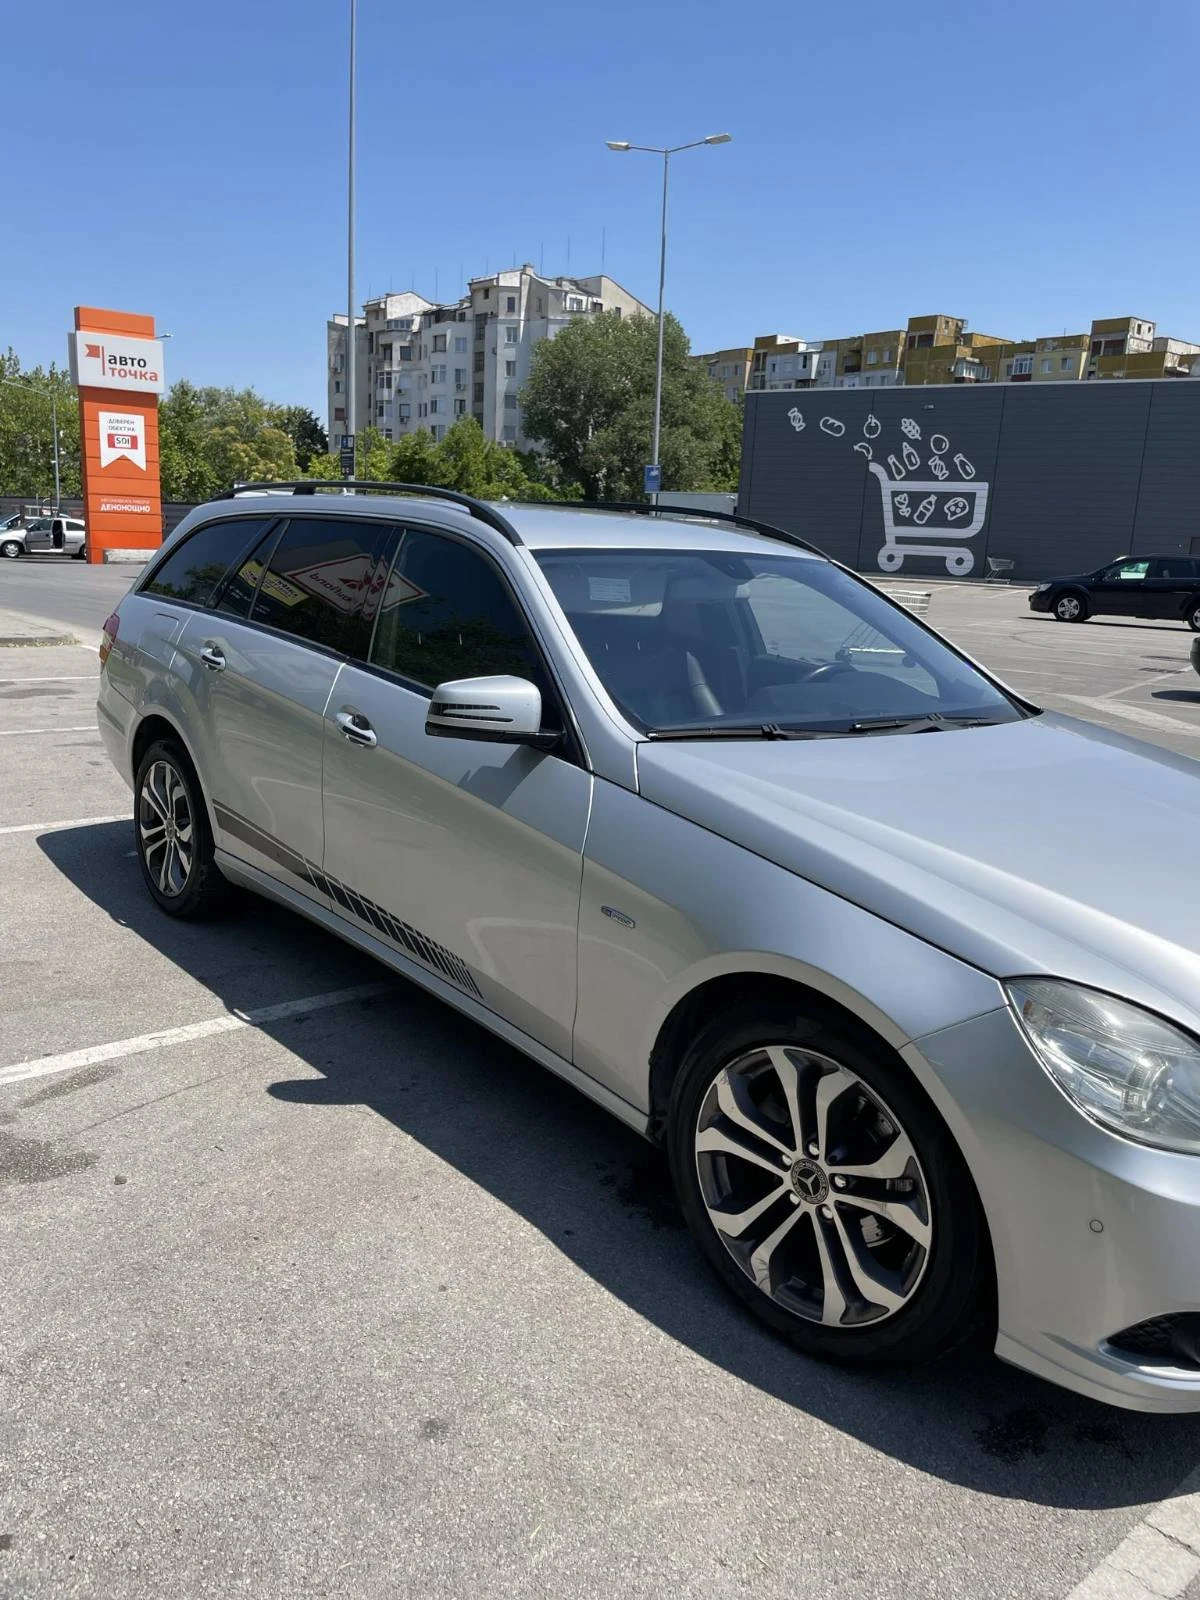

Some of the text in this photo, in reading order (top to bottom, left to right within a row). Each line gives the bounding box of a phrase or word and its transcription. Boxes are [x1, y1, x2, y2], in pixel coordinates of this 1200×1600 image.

[108, 354, 147, 368] авто
[109, 368, 158, 382] точка
[100, 503, 151, 513] ДЕНОНОЩНО
